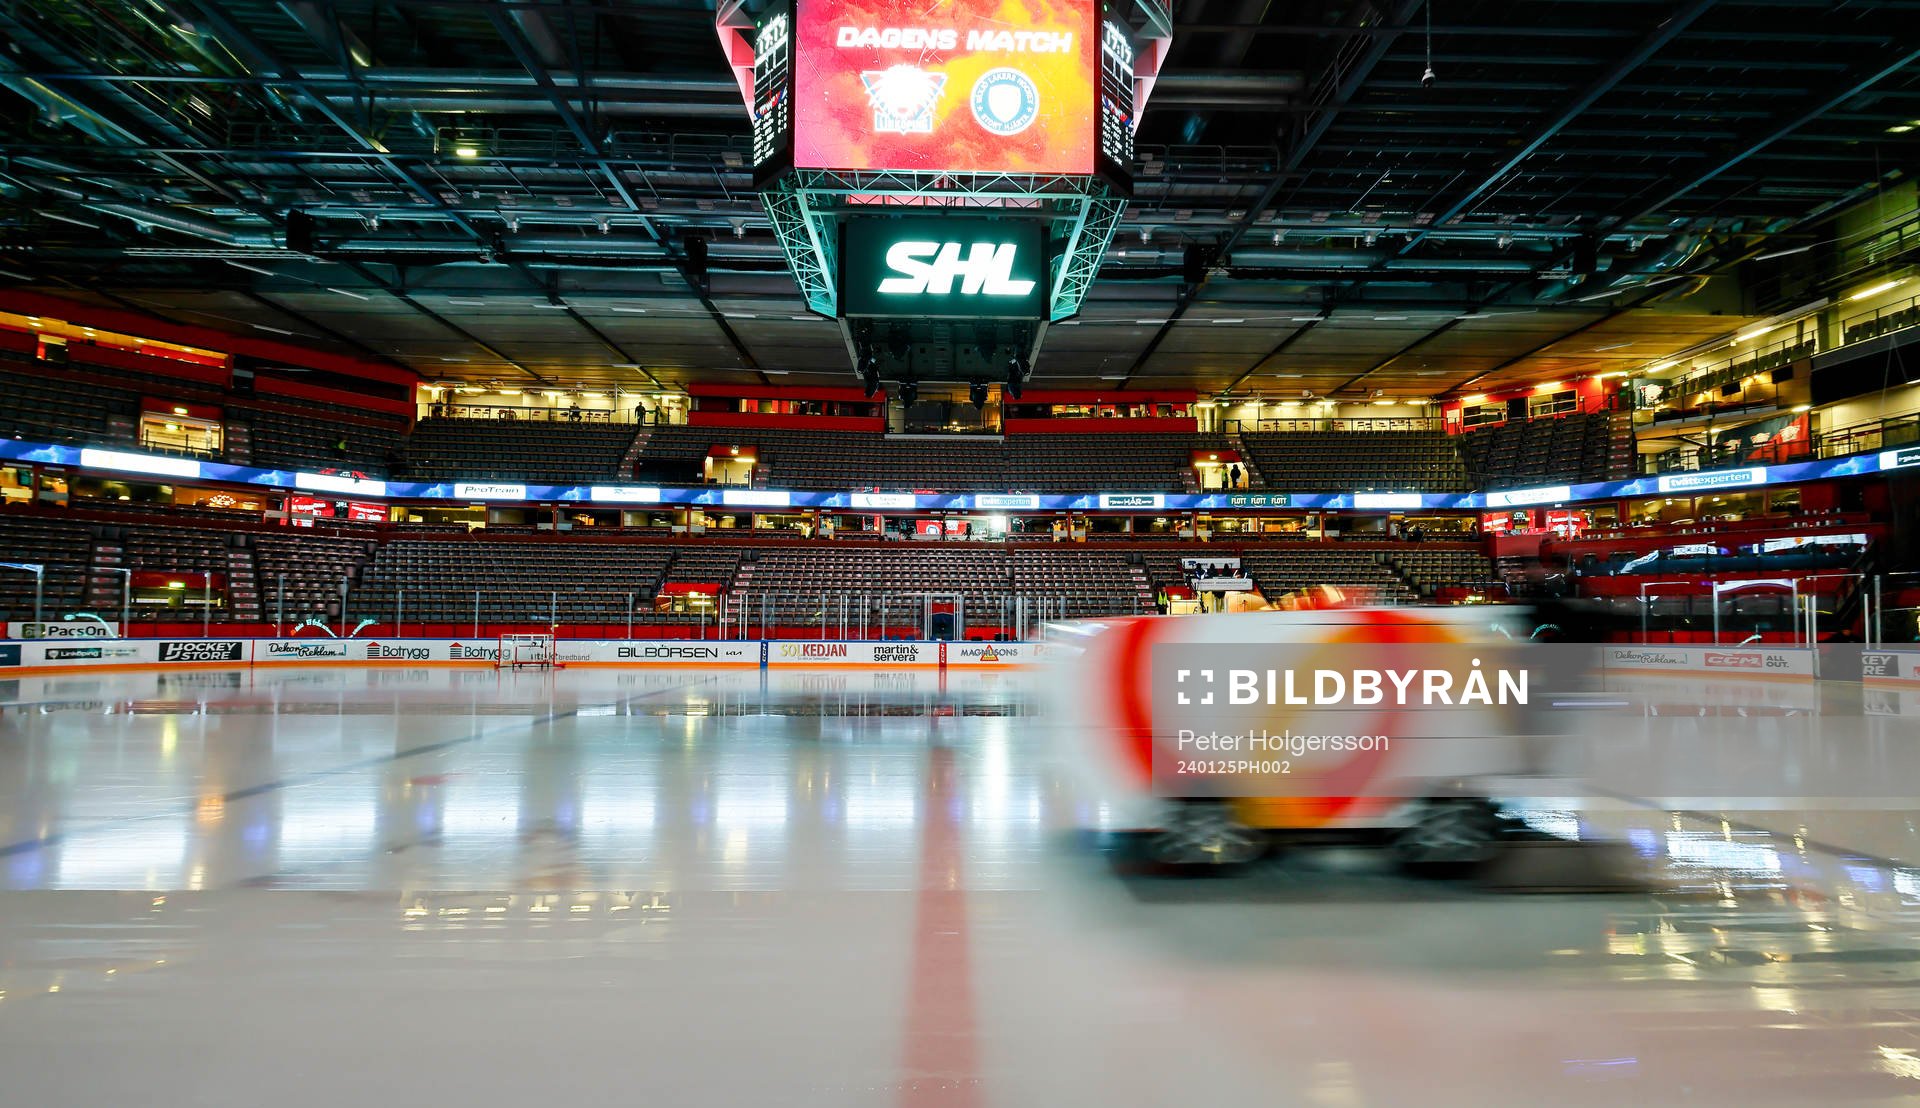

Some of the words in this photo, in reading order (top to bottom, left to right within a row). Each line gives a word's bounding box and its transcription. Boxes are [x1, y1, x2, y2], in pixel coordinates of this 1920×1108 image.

[836, 26, 958, 50] DAGENS
[967, 29, 1073, 53] MATCH
[876, 241, 1037, 296] SHL
[1671, 472, 1751, 487] tvättexperten
[464, 485, 519, 494] ProTrain
[1231, 497, 1247, 505] FLOTT
[1251, 497, 1266, 505] FLOTT
[1271, 497, 1287, 505] FLOTT
[48, 625, 107, 637] PacsOn
[166, 643, 236, 653] HOCKEY
[269, 642, 299, 653] Dekor
[298, 647, 337, 657] Reklam
[382, 645, 430, 659] Botrygg
[464, 646, 511, 660] Botrygg
[617, 644, 718, 658] BILBÖRSEN
[781, 643, 847, 657] SOLKEDJAN
[874, 644, 919, 654] martin&
[181, 651, 232, 660] STORE
[558, 653, 590, 661] bredband
[874, 653, 916, 662] servera
[1614, 650, 1641, 659] Dekor
[1640, 653, 1678, 664] Reklam
[1706, 655, 1761, 666] CCM
